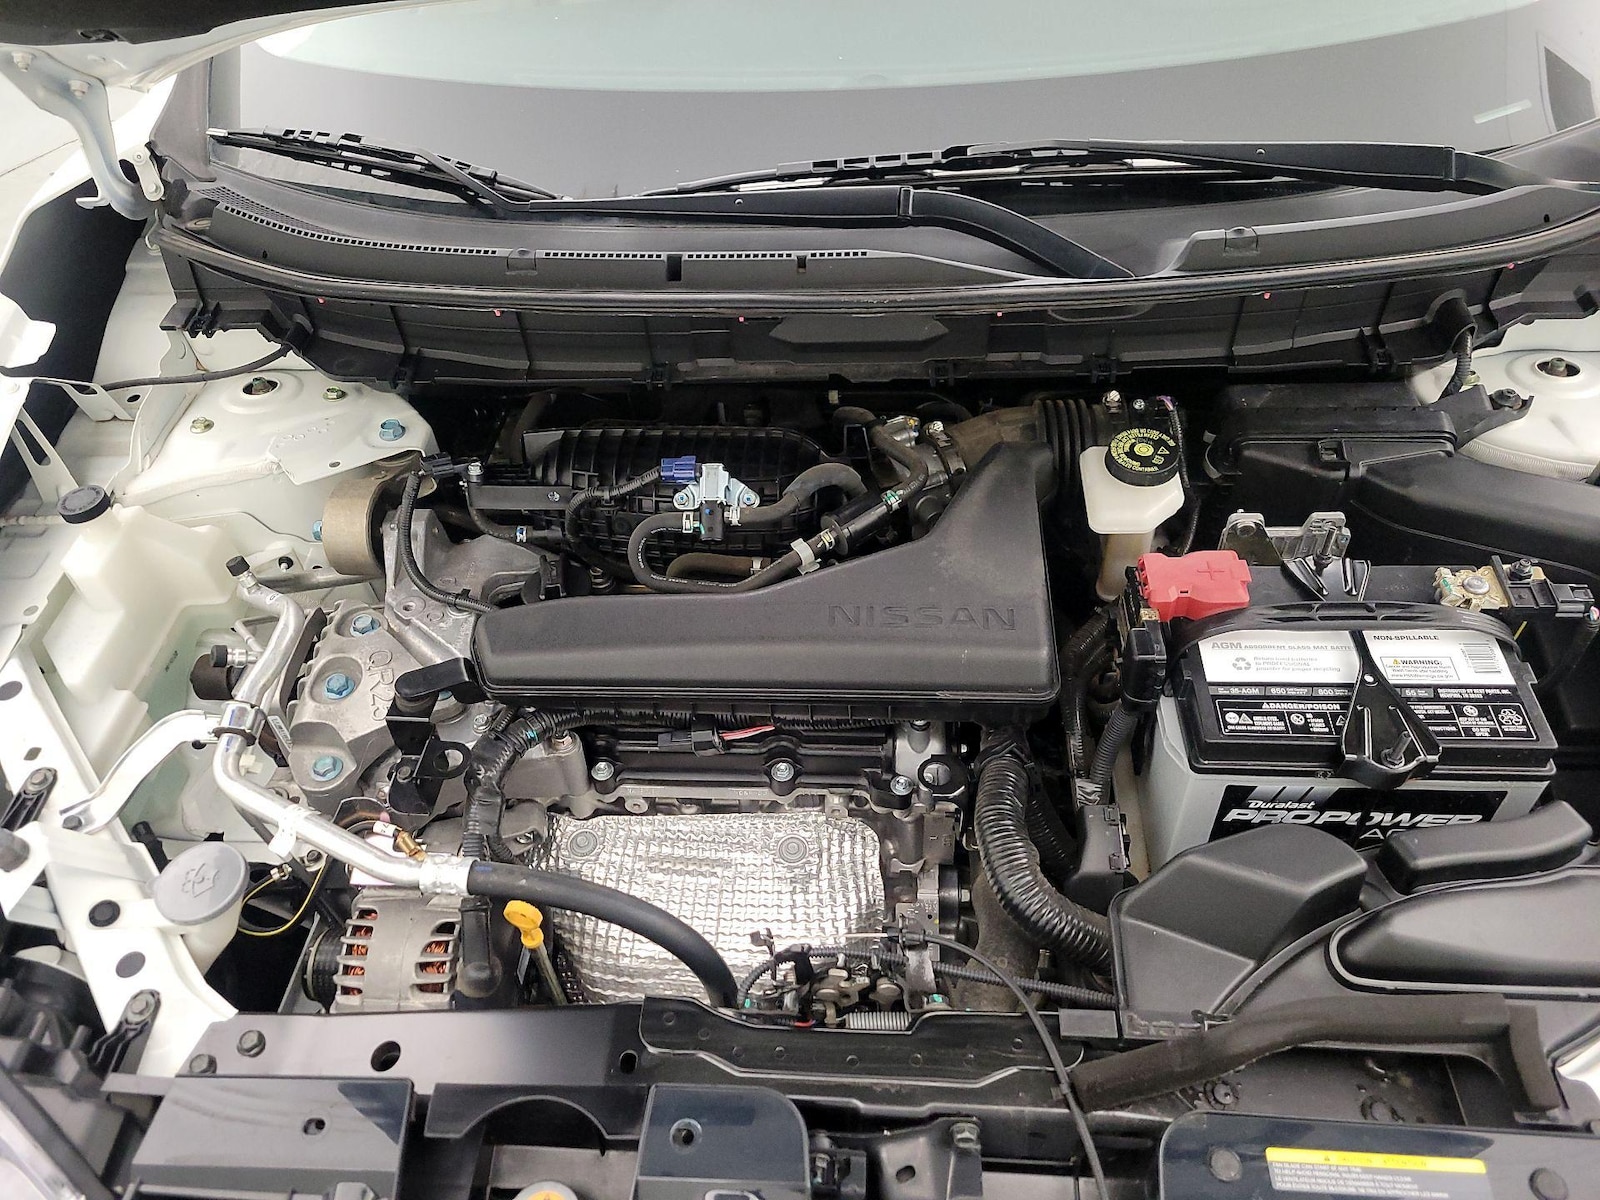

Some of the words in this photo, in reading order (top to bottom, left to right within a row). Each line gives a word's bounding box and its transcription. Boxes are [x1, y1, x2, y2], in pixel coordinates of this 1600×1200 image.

[828, 605, 1016, 631] NISSAN
[1211, 641, 1243, 649] AGM
[1269, 702, 1340, 710] DANGER/POISON
[1248, 800, 1316, 810] Duralast
[1222, 808, 1483, 828] PROPOWER
